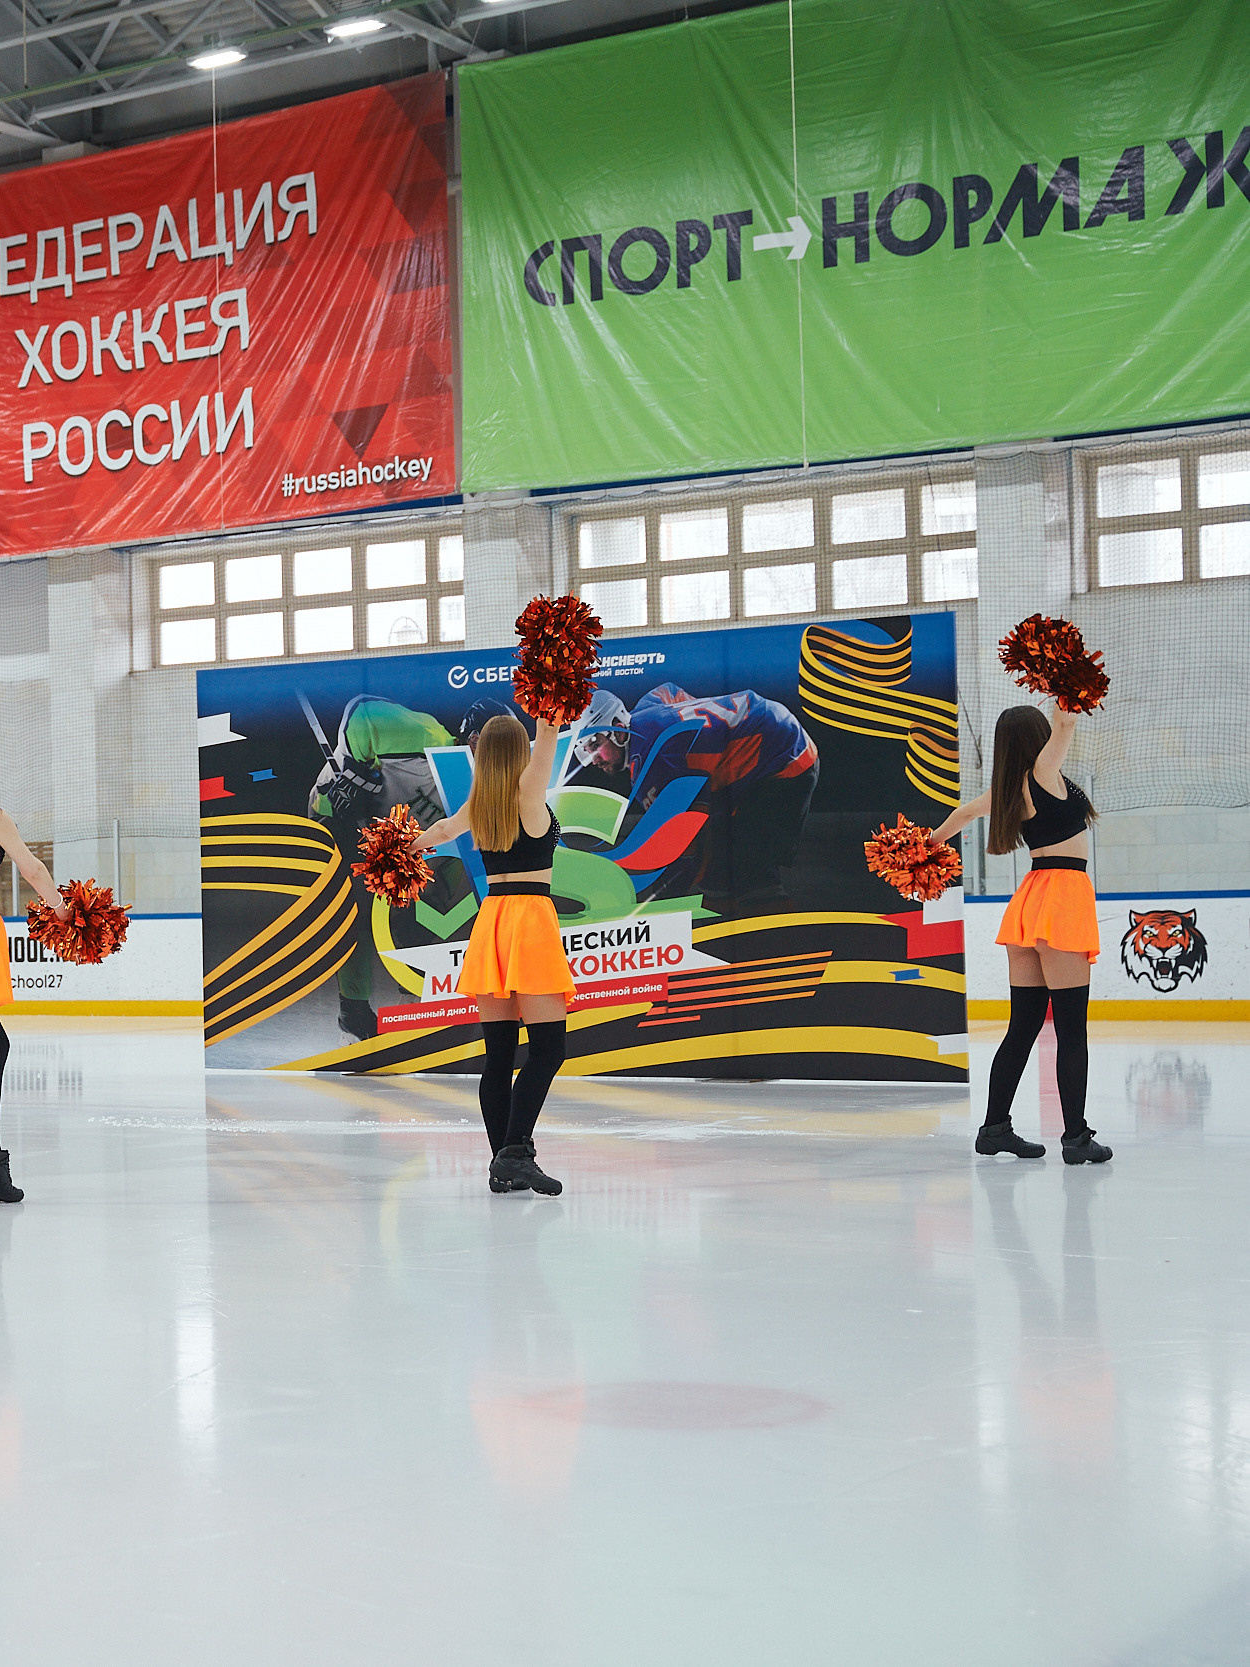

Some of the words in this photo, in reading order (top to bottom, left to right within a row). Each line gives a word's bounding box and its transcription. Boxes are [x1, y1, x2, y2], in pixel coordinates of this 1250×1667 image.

[523, 209, 753, 307] СПОРТ
[822, 145, 1145, 269] НОРМА
[14, 287, 250, 388] ХОККЕЯ
[22, 386, 254, 482] РОССИИ
[281, 455, 433, 497] #russiahockey
[614, 667, 644, 676] ВОСТОК
[8, 936, 67, 963] OOL.
[382, 1009, 445, 1024] посвященный
[446, 1008, 467, 1017] дню
[632, 983, 663, 995] войне
